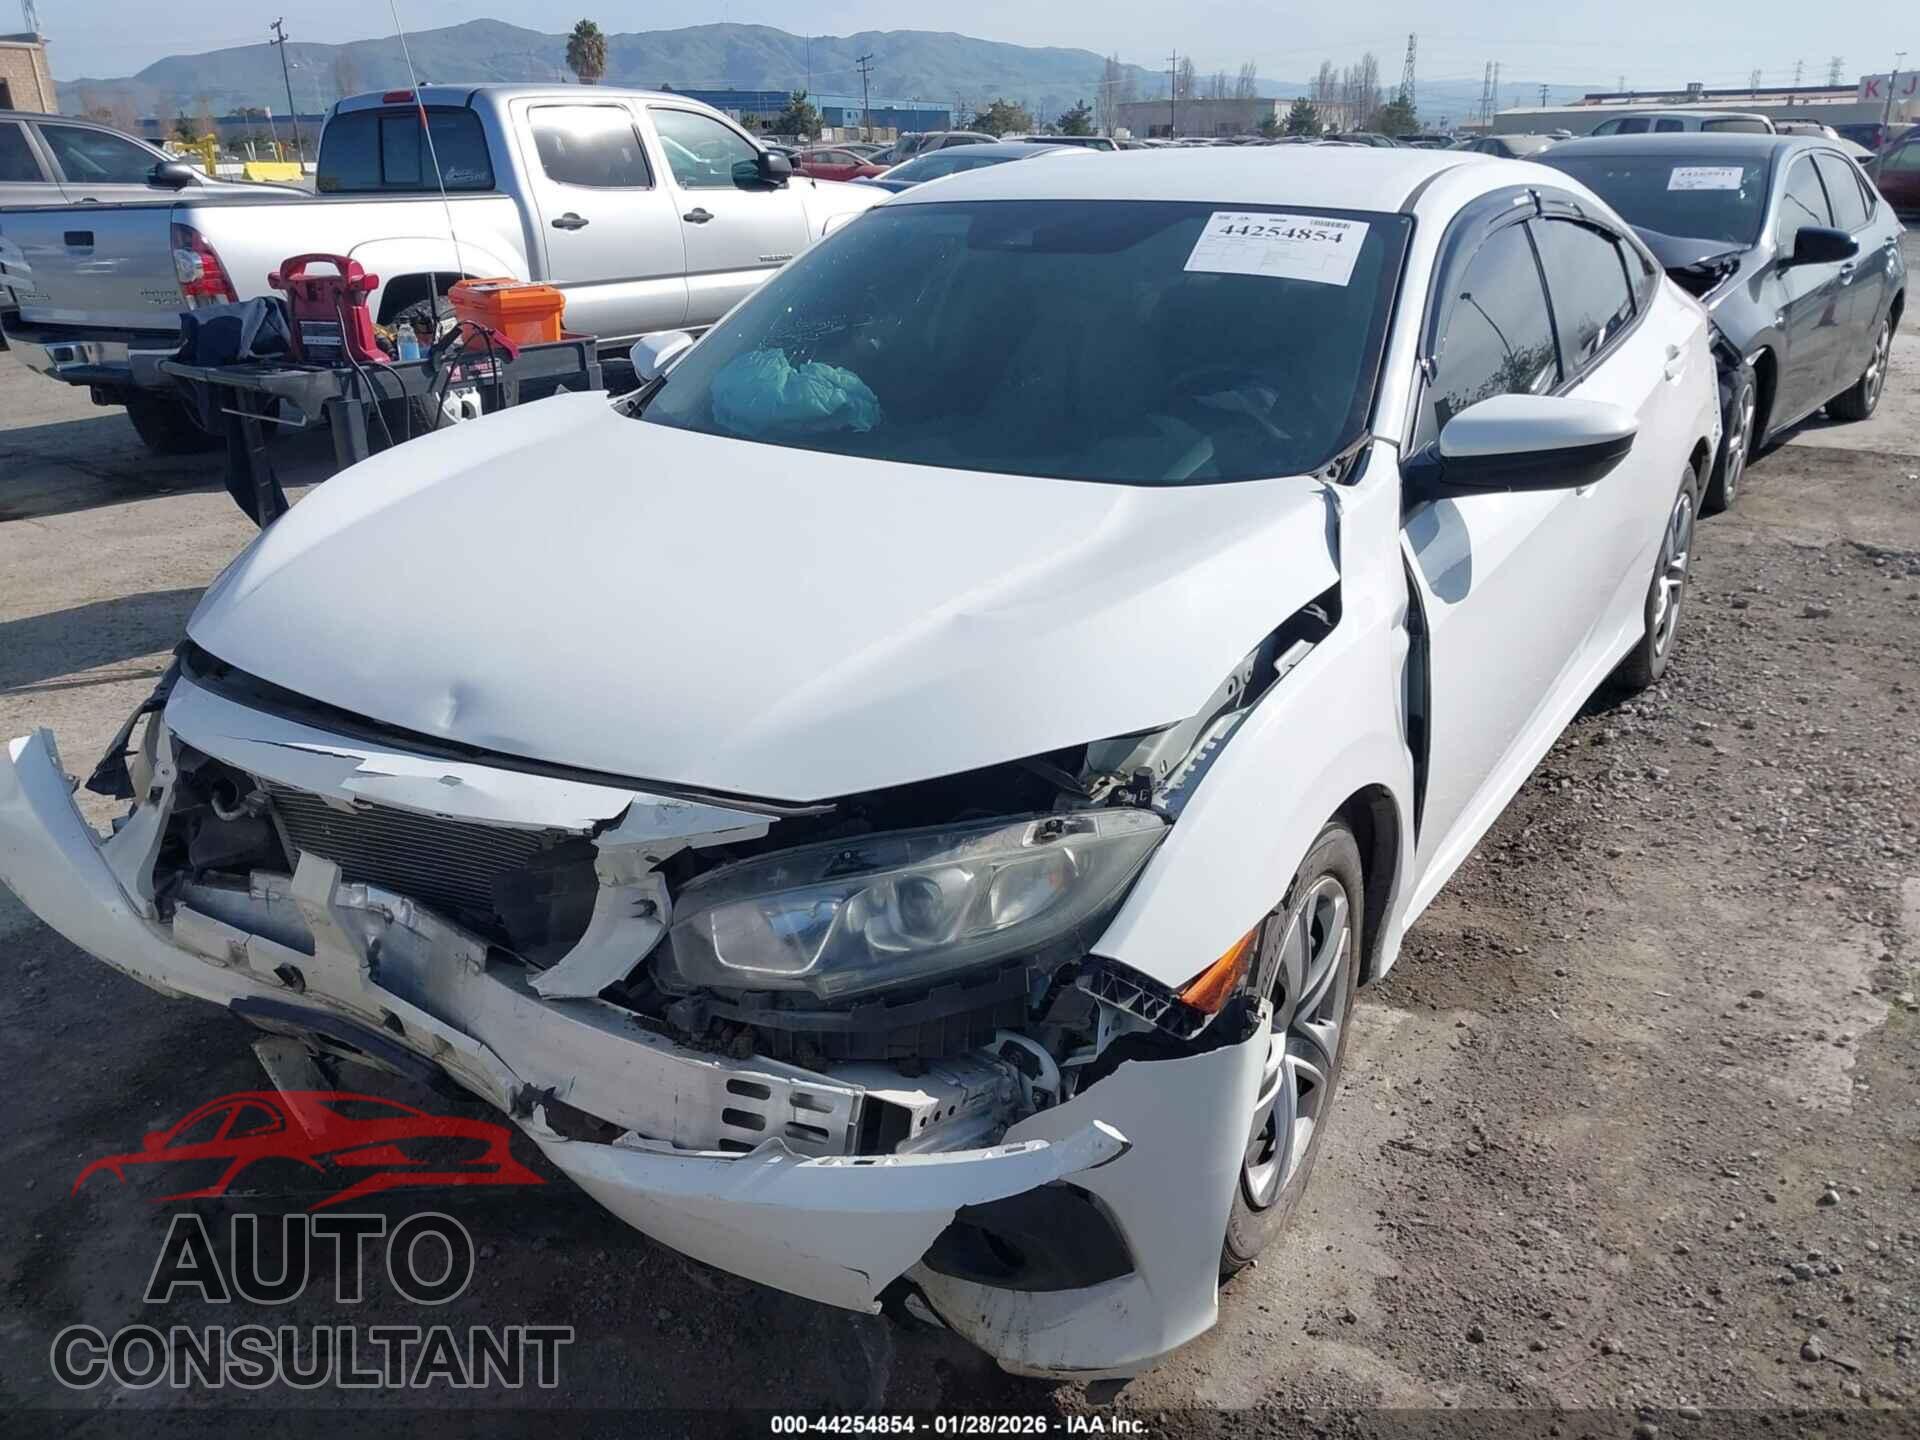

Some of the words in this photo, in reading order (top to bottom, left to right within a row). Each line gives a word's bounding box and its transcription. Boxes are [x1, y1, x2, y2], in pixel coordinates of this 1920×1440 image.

[1865, 79, 1881, 98] K
[1902, 76, 1917, 95] J
[1219, 224, 1344, 243] 44254854
